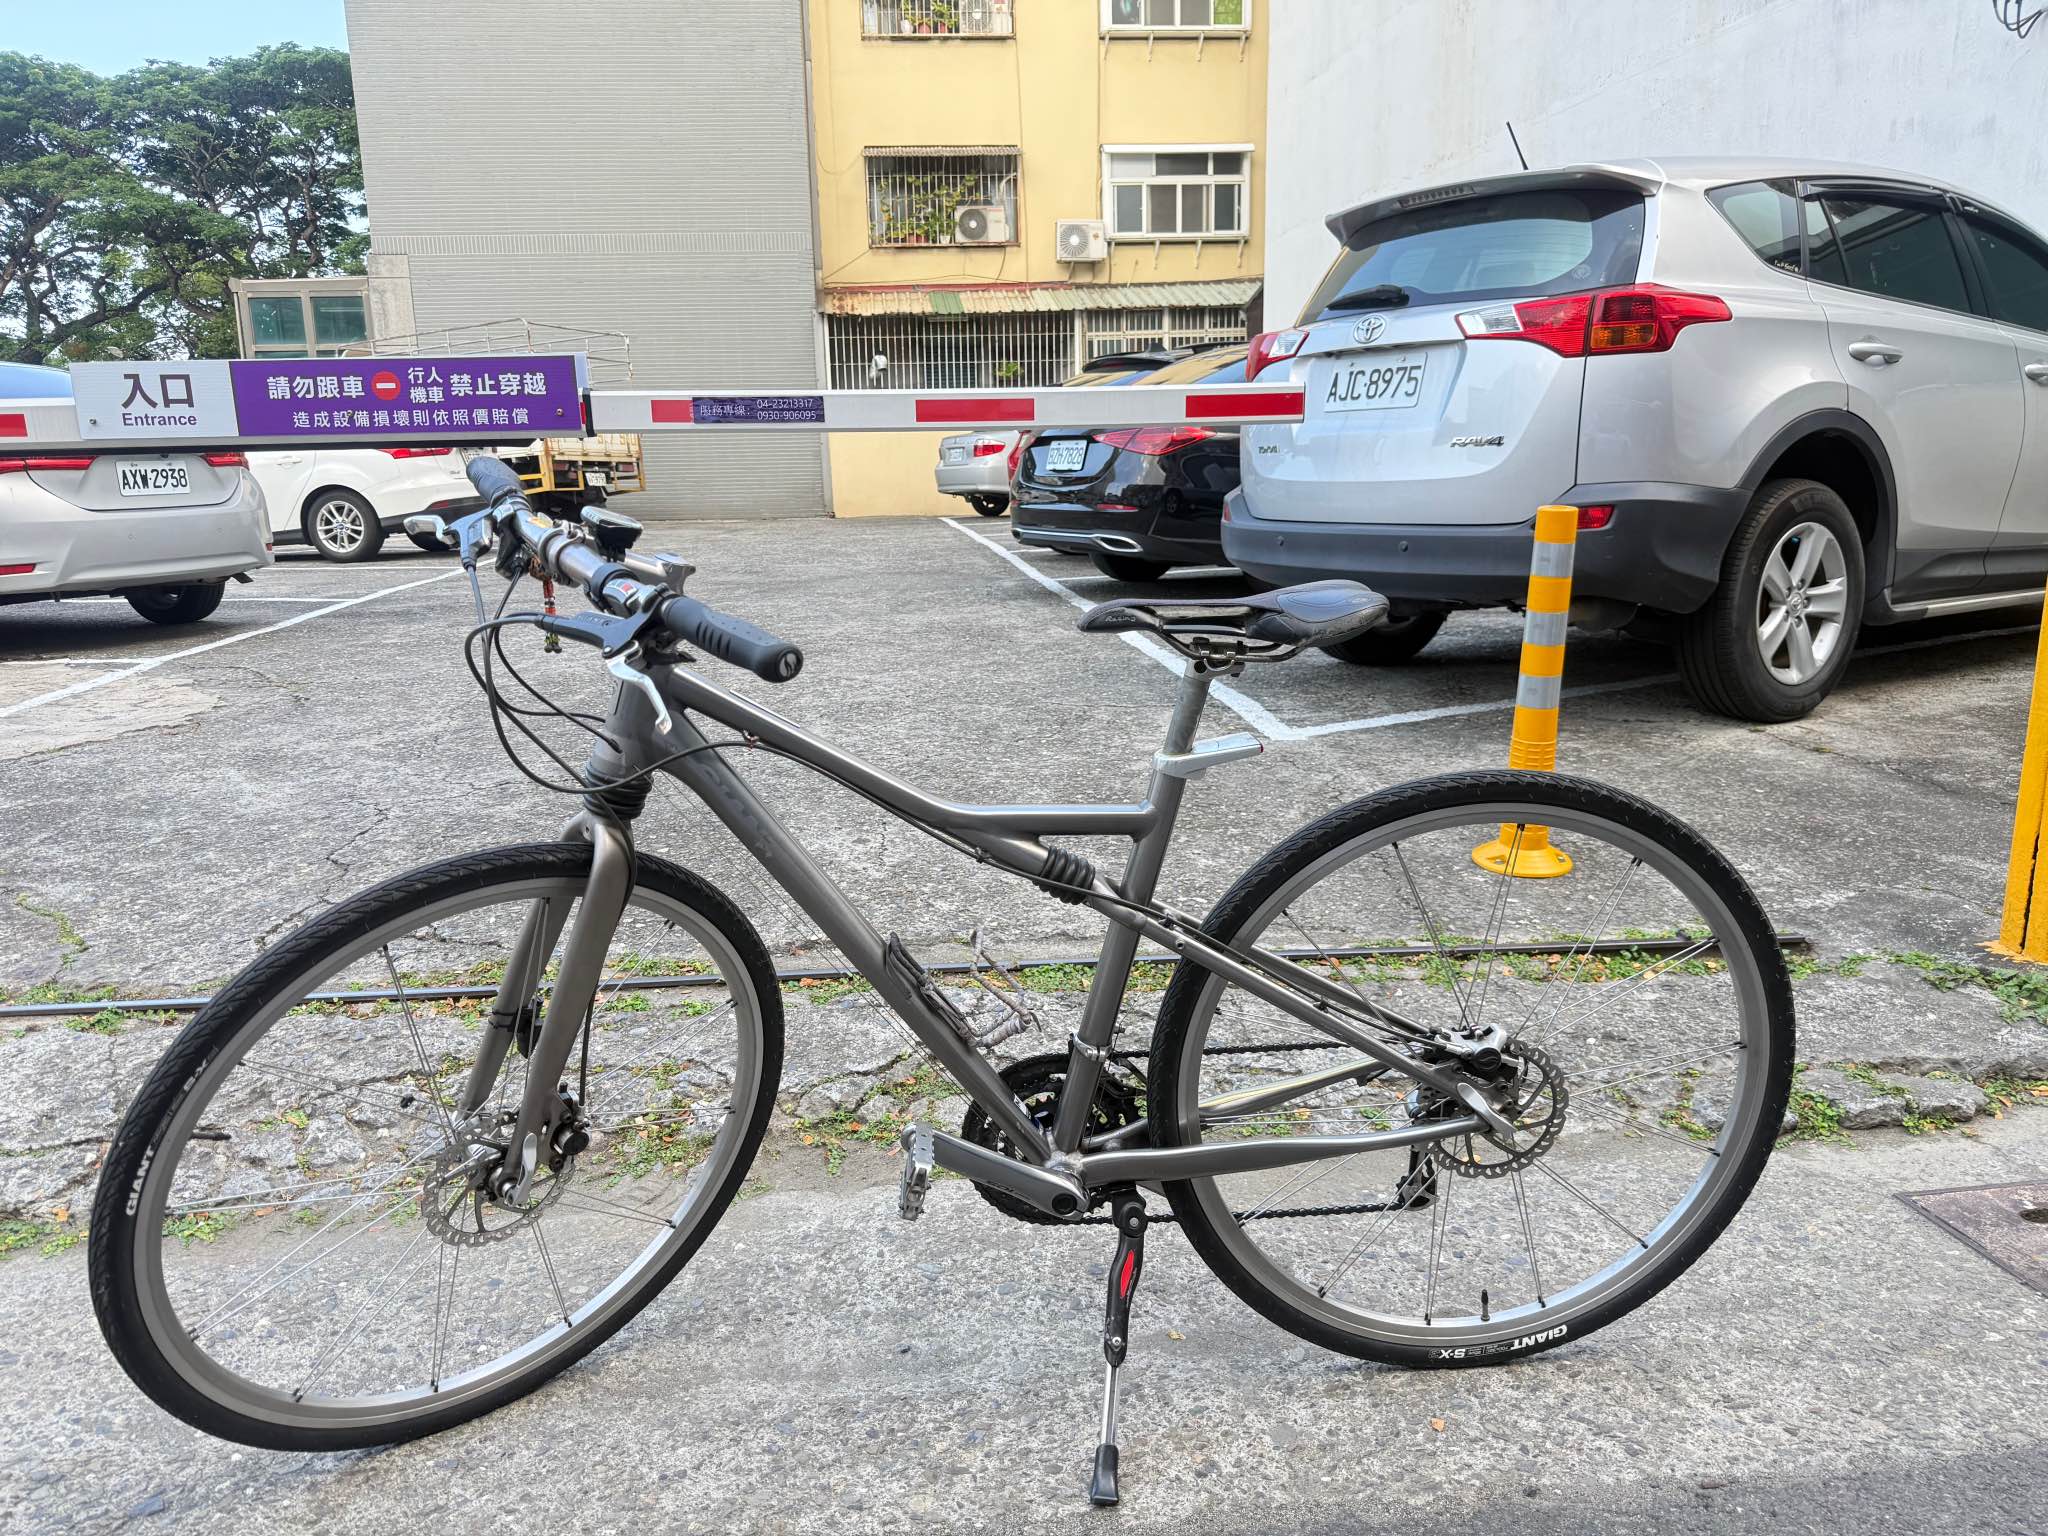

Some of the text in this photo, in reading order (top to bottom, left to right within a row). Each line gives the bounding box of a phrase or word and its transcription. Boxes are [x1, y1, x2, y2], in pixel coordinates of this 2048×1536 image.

[408, 366, 444, 384] 行人
[449, 372, 547, 397] 禁止穿越
[121, 373, 195, 409] 入口
[266, 375, 366, 400] 請勿跟車
[409, 385, 445, 404] 機車
[756, 398, 813, 409] 04-23213317
[121, 412, 198, 427] Entrance
[293, 407, 529, 428] 造成設備損壞則依照價賠償
[757, 410, 817, 421] 0930-906095
[1449, 434, 1505, 448] RAV4
[126, 1144, 155, 1217] GIANT
[1510, 1324, 1568, 1351] GIANT
